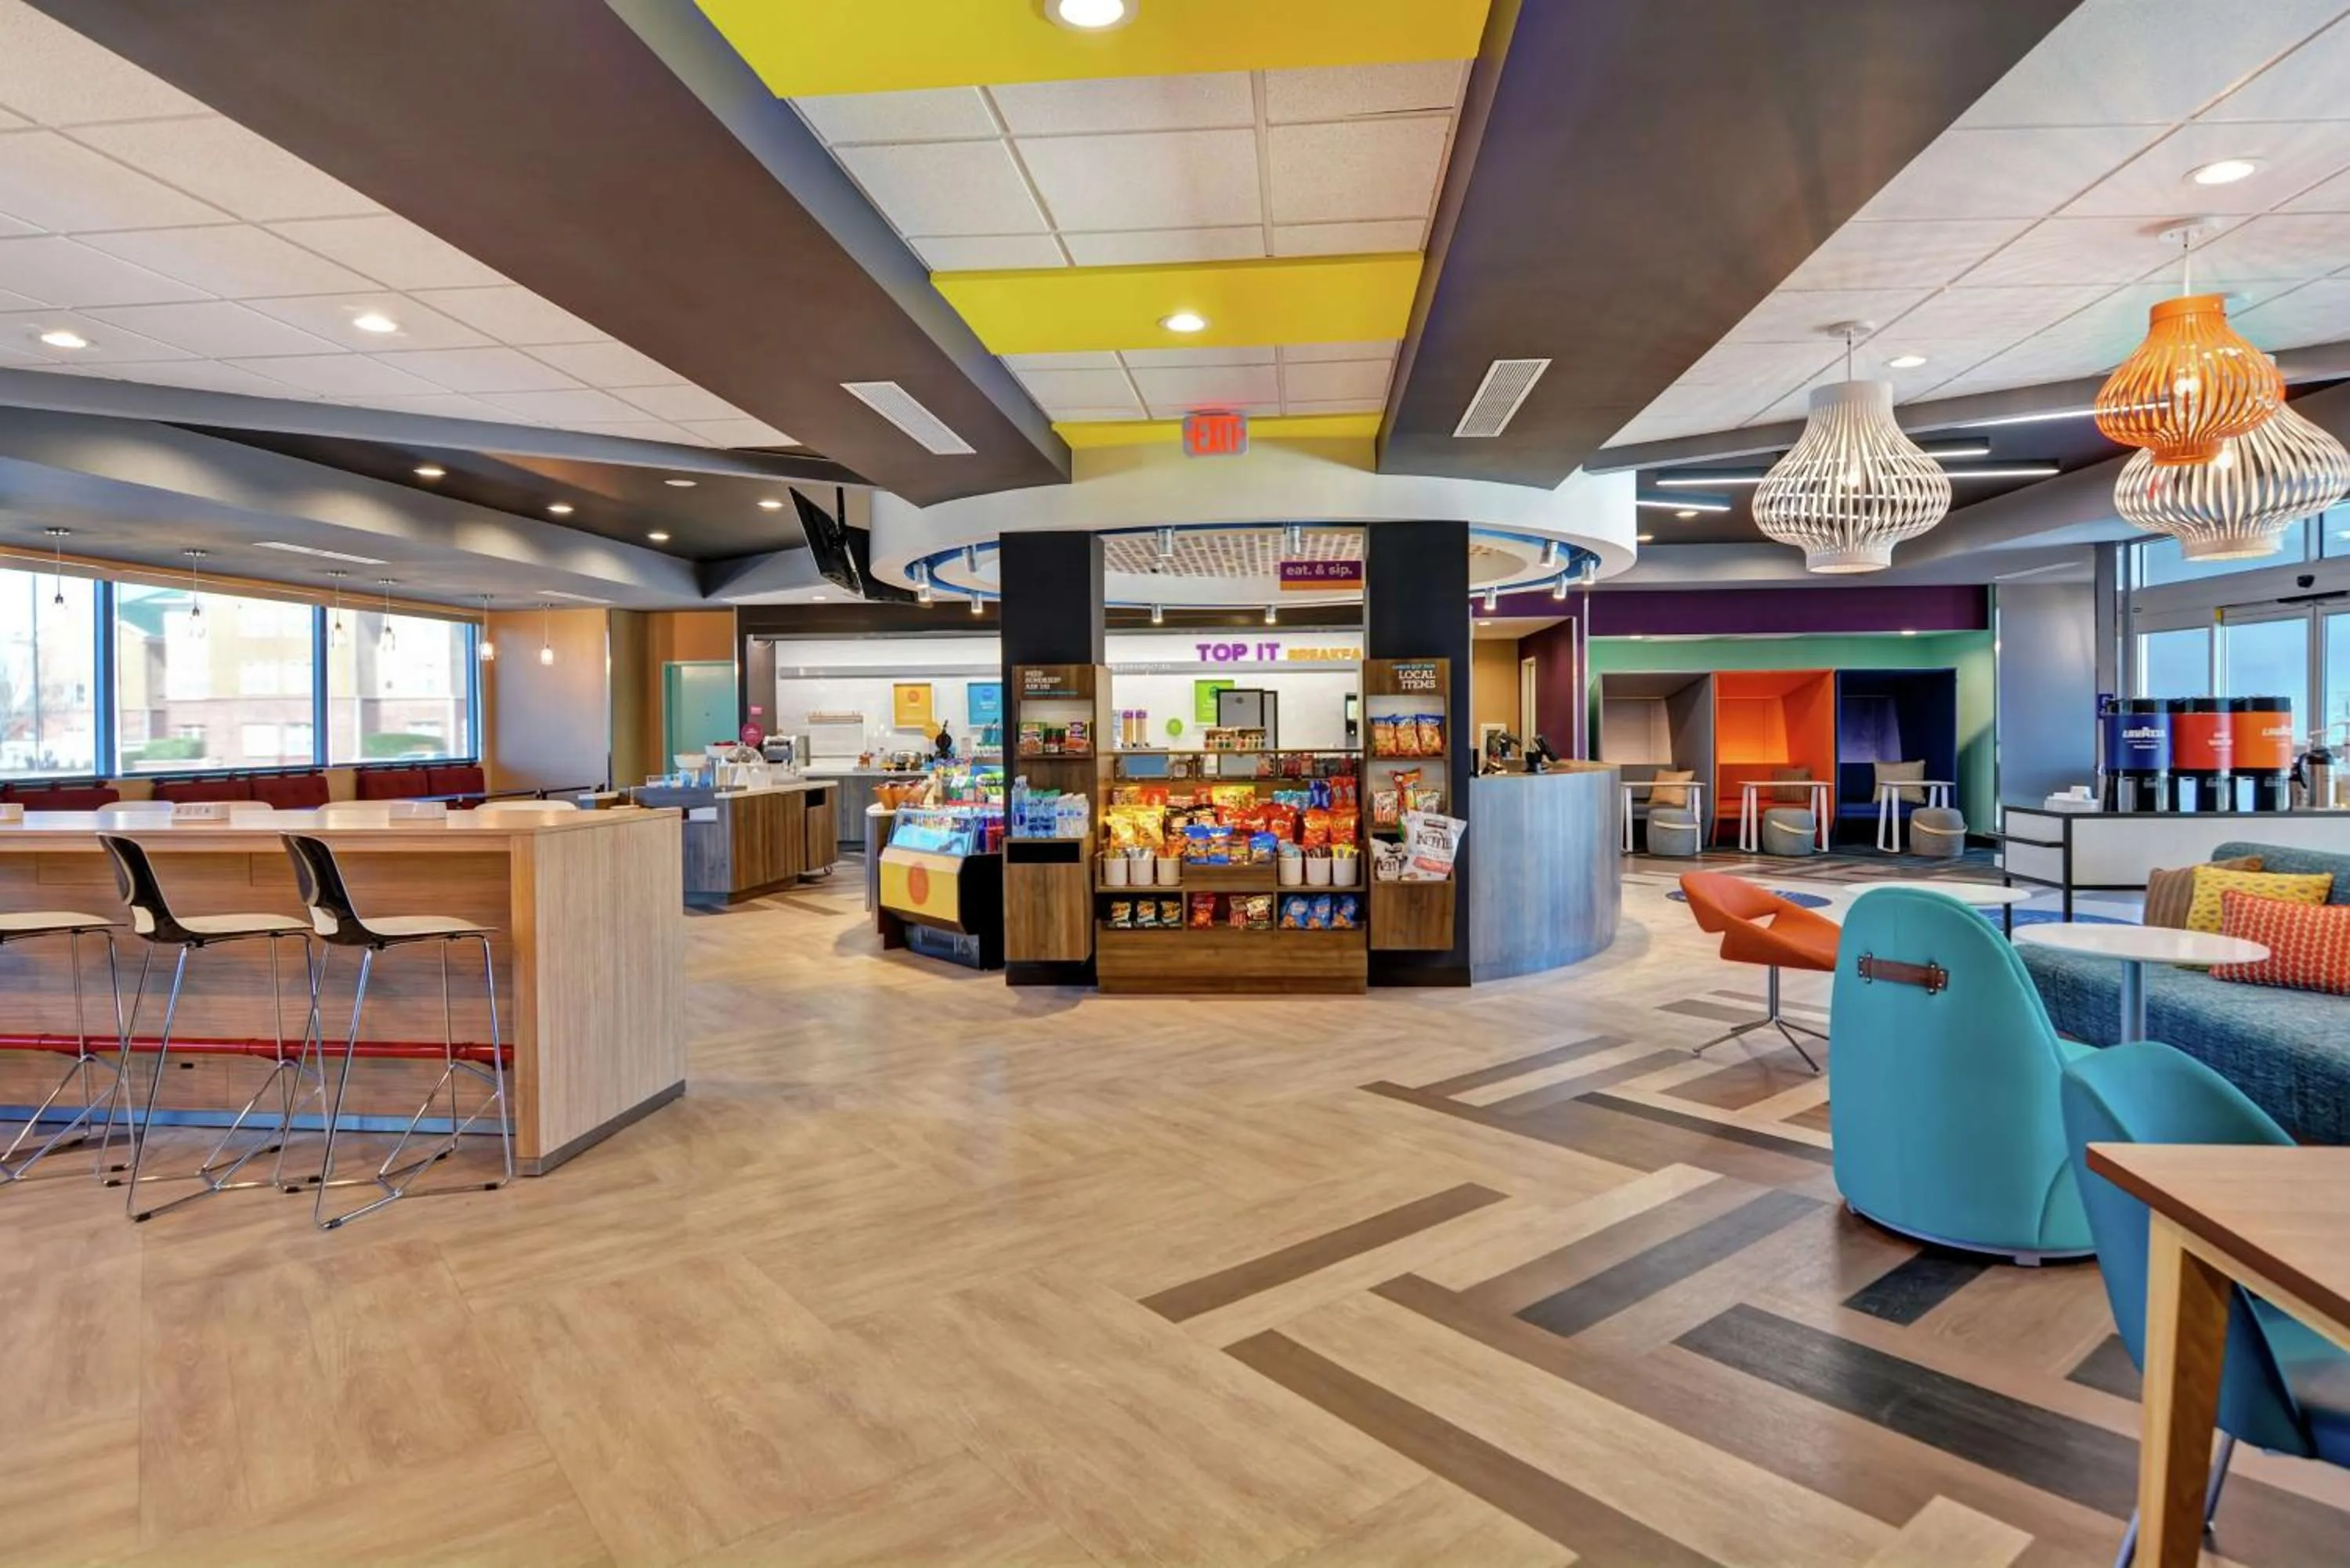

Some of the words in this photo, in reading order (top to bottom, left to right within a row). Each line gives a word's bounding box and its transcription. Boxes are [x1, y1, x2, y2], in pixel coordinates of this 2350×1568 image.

[1193, 418, 1239, 453] EXIT
[1285, 565, 1312, 576] eat.
[1315, 564, 1325, 576] &
[1328, 563, 1353, 577] sip.
[1196, 643, 1248, 661] TOP
[1256, 642, 1281, 661] IT
[1398, 670, 1436, 679] LOCAL
[1402, 679, 1436, 689] ITEMS
